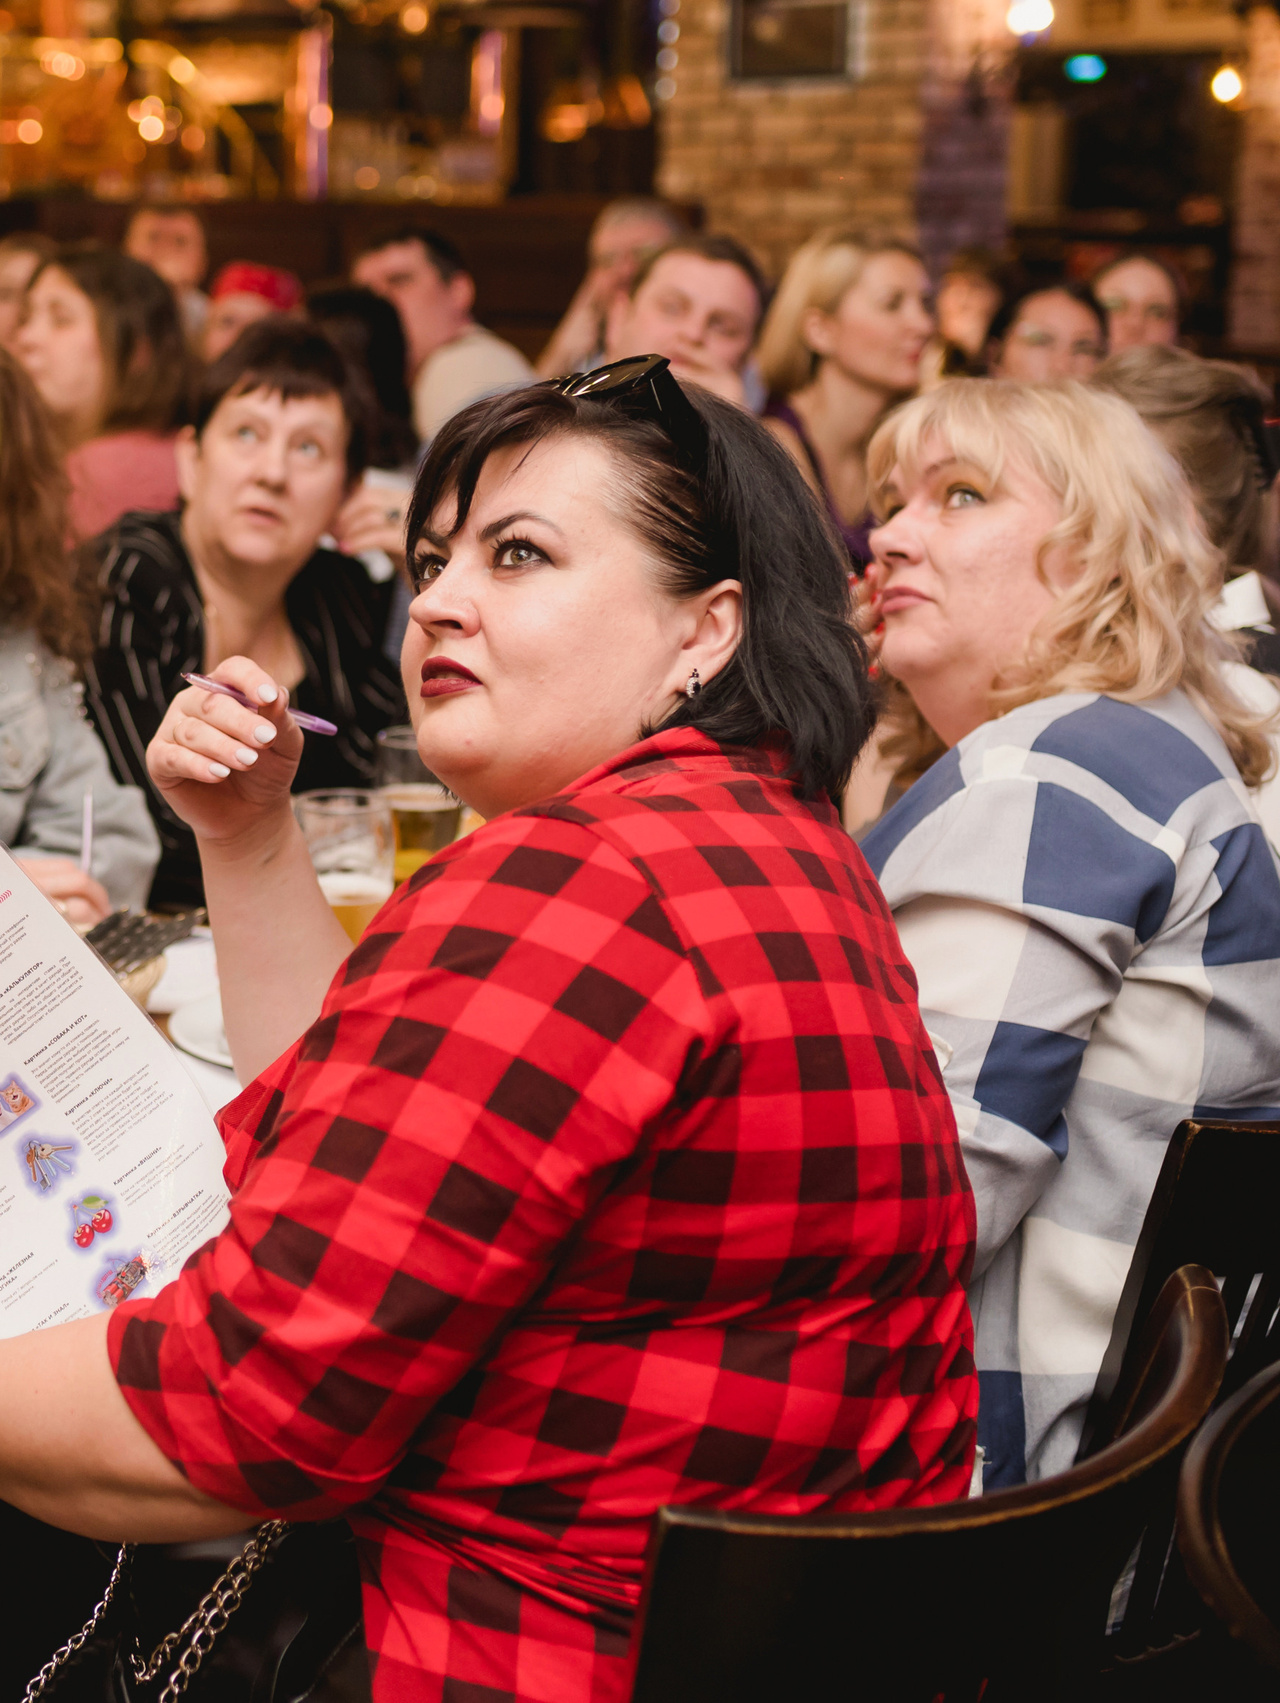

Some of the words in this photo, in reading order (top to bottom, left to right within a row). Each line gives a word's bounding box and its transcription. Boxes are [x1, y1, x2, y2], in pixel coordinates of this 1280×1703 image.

[3, 961, 43, 994] «КАЛЬКУЛЯТОР»
[24, 1045, 48, 1066] Картинка
[47, 1027, 70, 1047] «СОБАКА
[74, 1014, 88, 1025] КОТ»
[65, 1096, 89, 1117] Картинка
[88, 1077, 113, 1098] «КЛЮЧИ»
[6, 1252, 34, 1276] «ЖЕЛЕЗНАЯ
